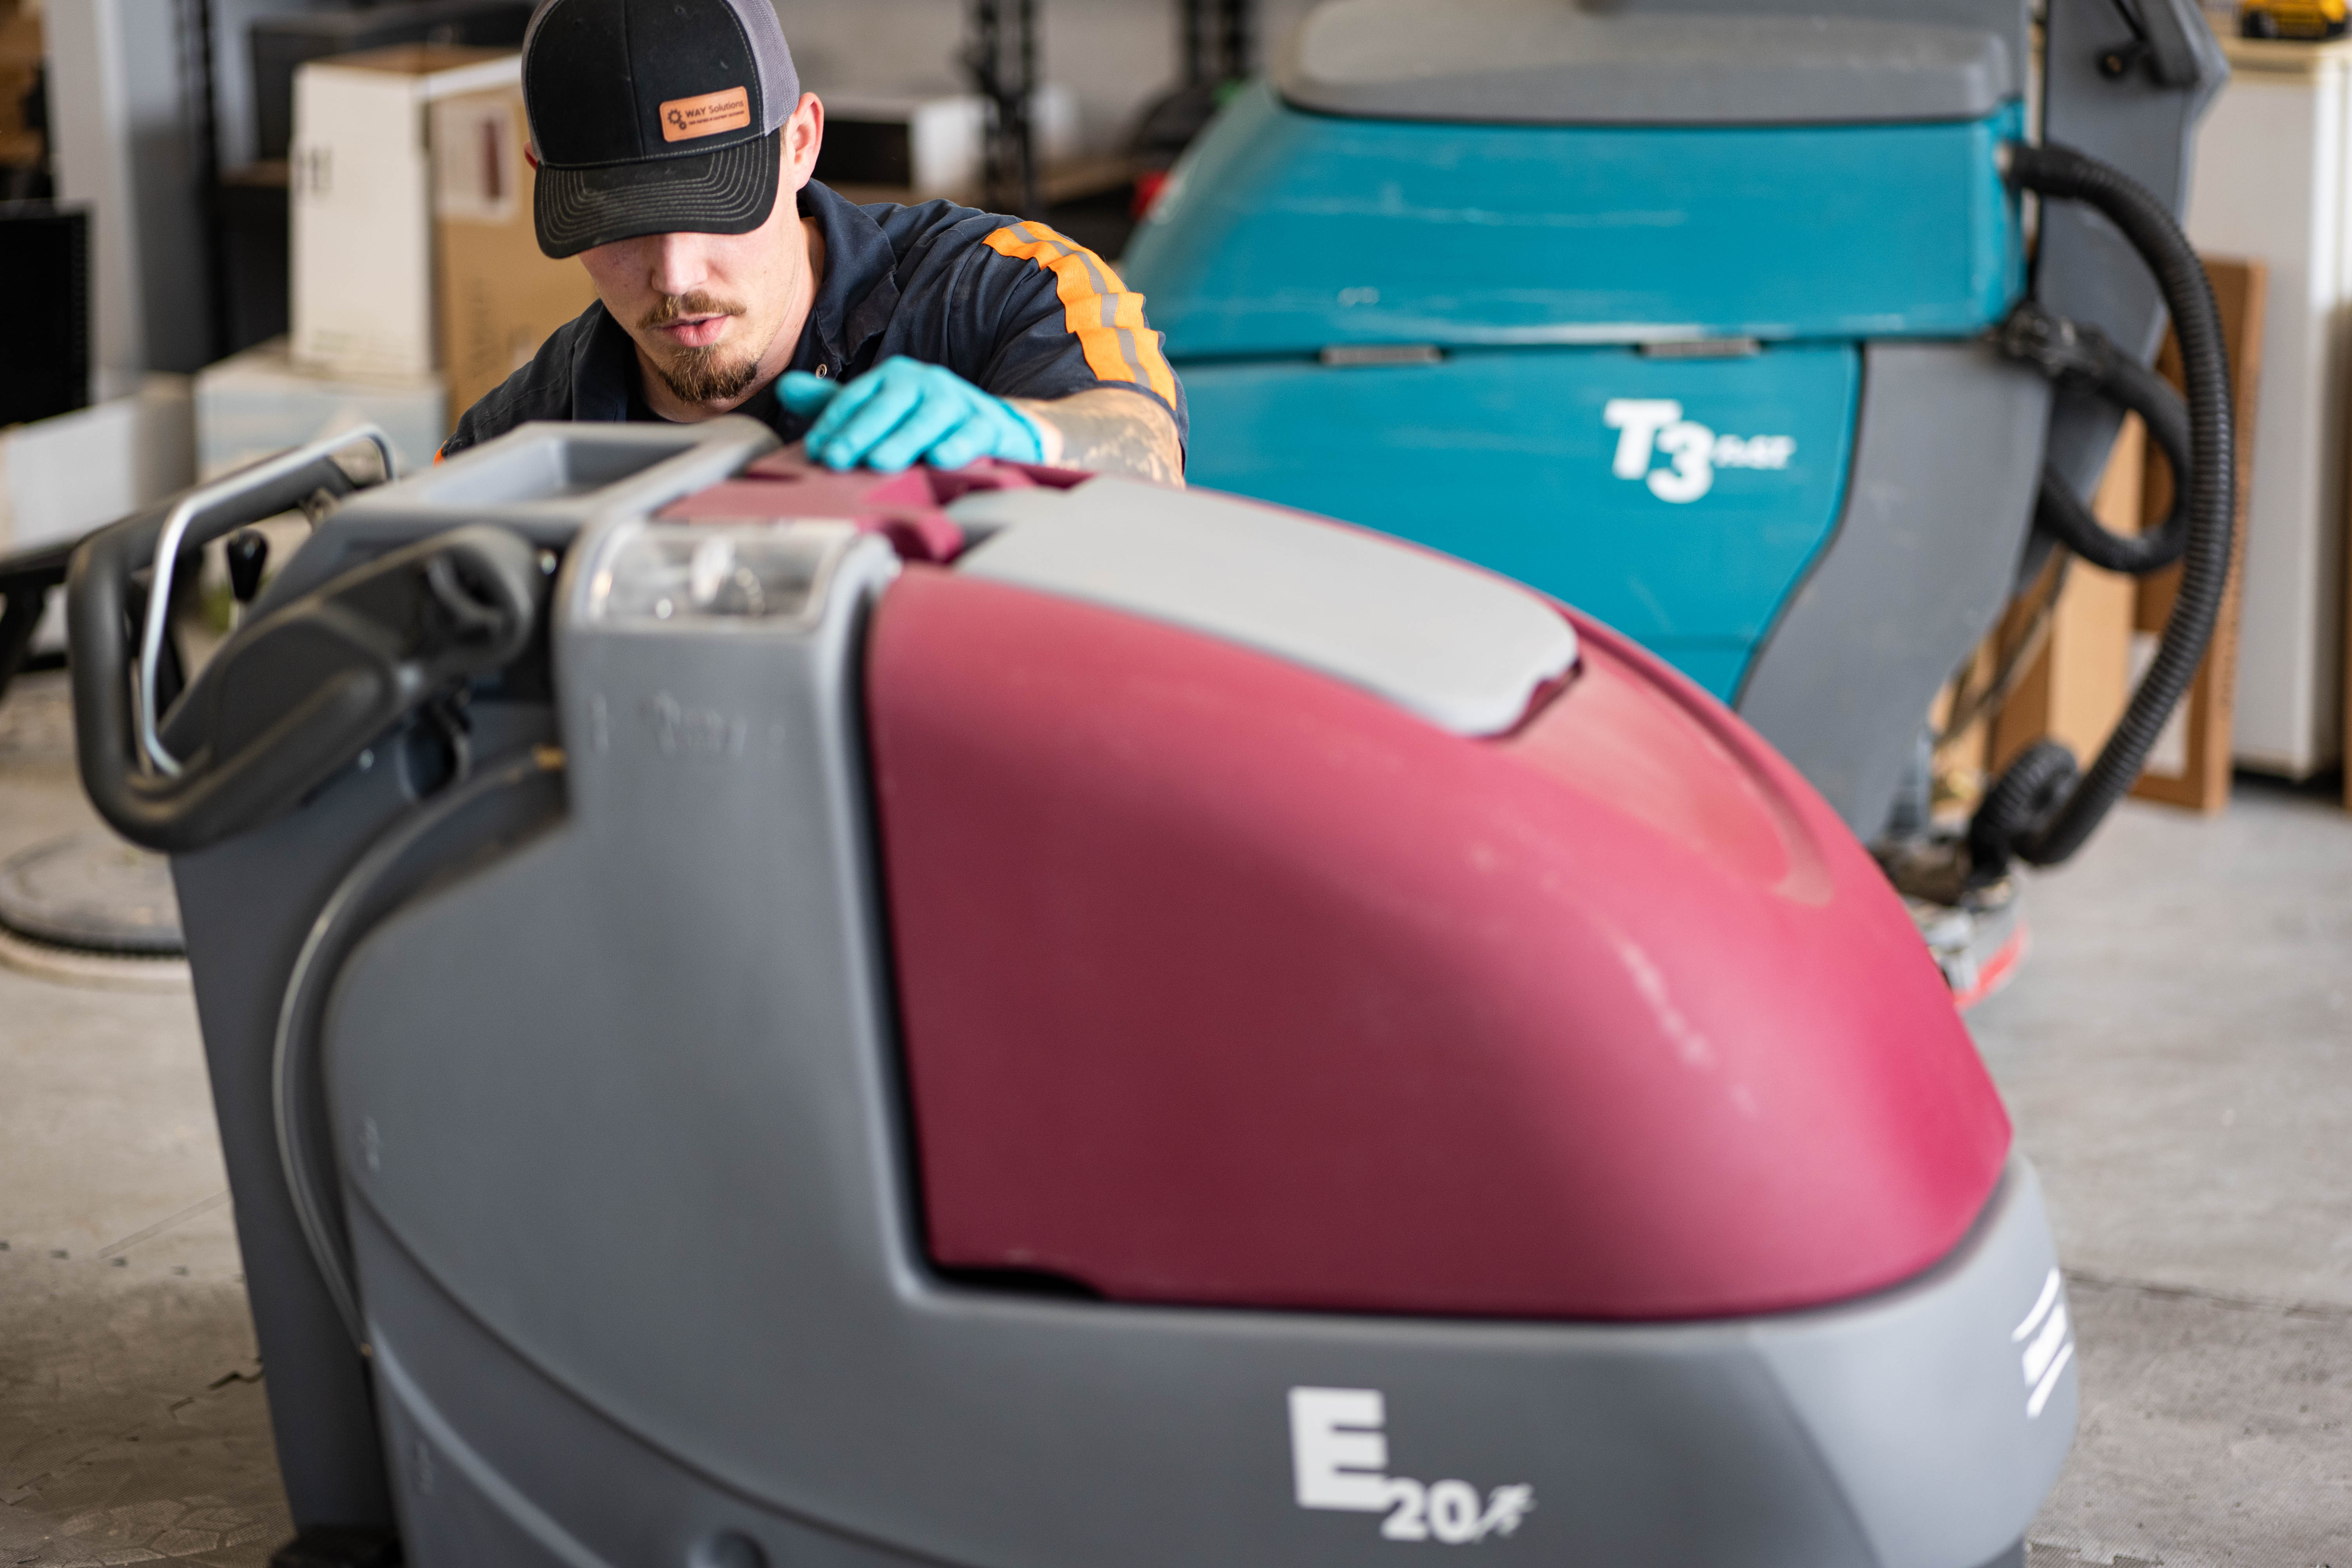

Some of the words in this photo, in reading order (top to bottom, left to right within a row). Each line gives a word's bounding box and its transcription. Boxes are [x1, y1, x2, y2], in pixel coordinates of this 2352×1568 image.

[685, 106, 706, 118] WAY
[708, 100, 744, 114] Solutions
[1604, 398, 1715, 503] T3
